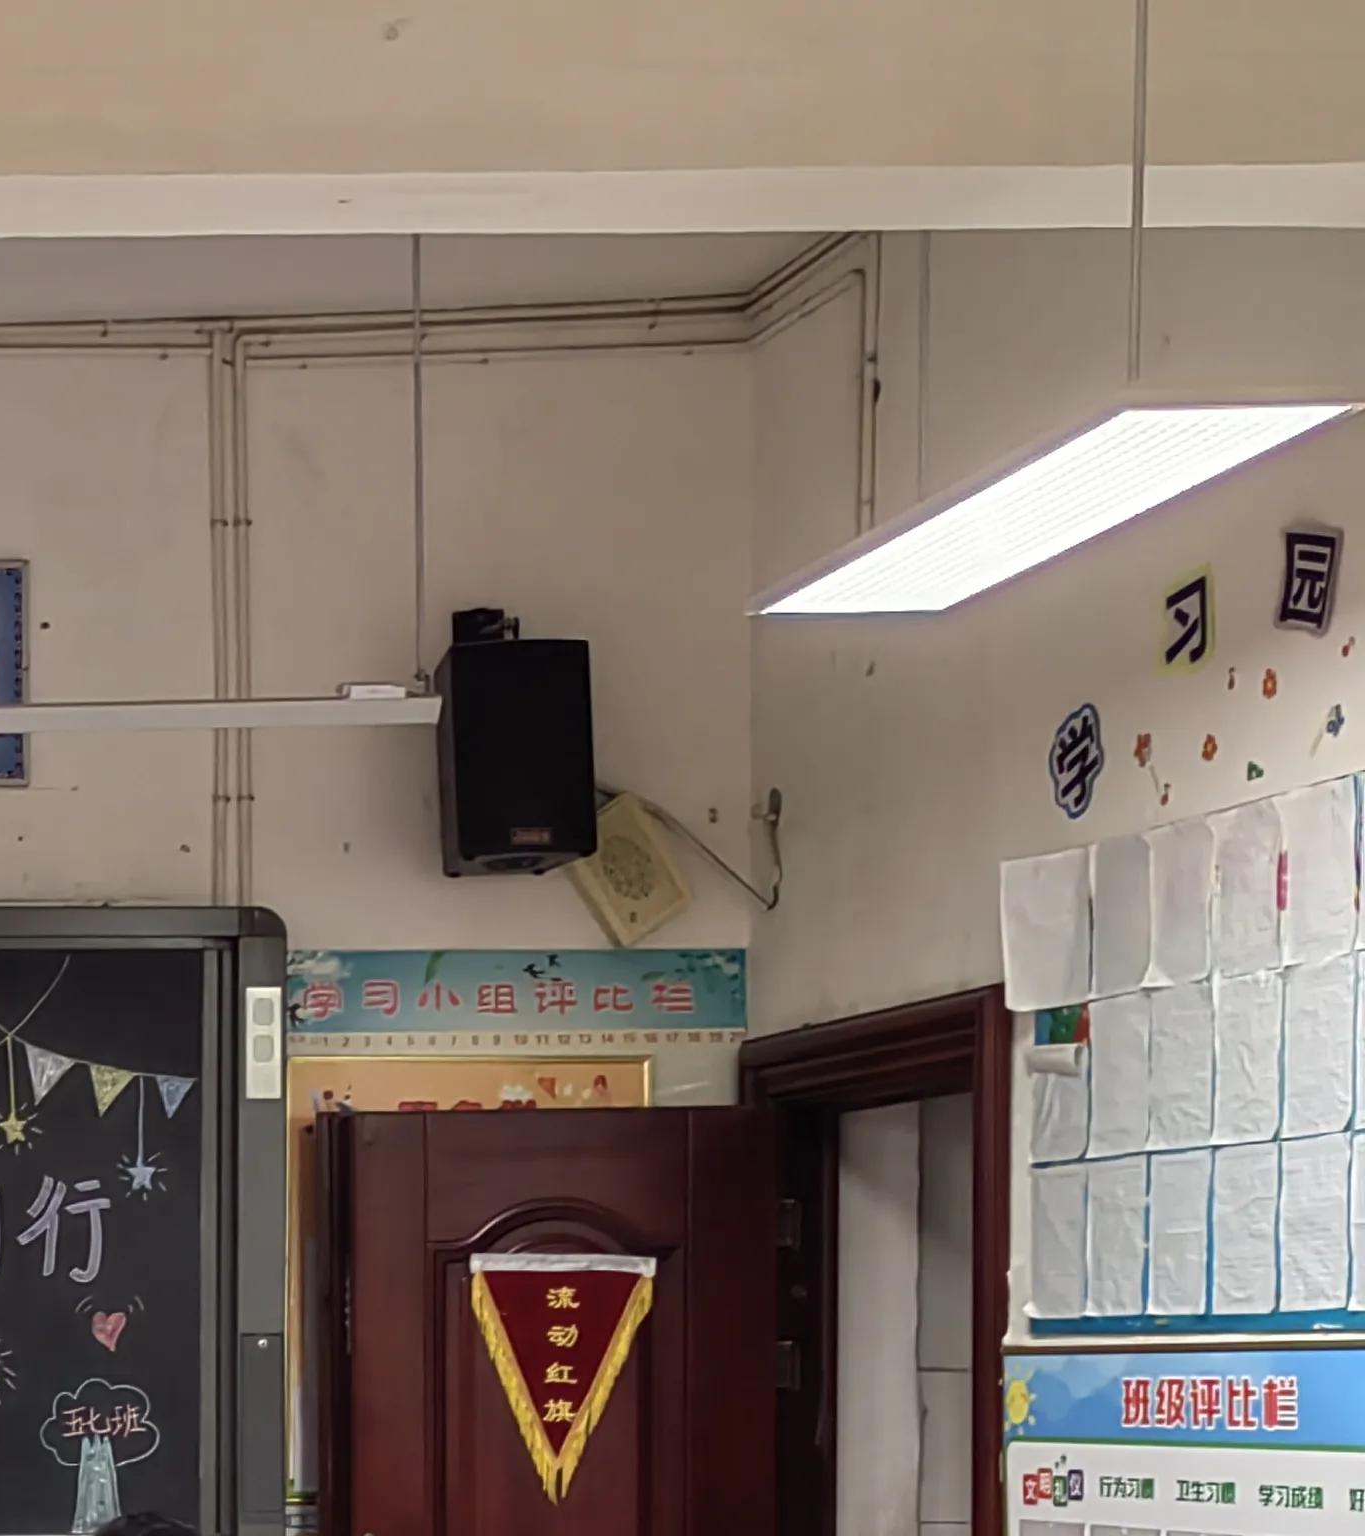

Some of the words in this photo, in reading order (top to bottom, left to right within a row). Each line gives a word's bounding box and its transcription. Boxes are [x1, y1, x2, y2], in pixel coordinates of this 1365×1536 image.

[302, 980, 697, 1018] 学习小组评比栏
[543, 1286, 581, 1424] 流动红旗
[61, 1403, 147, 1439] 五七班
[1122, 1375, 1298, 1430] 班级评比栏
